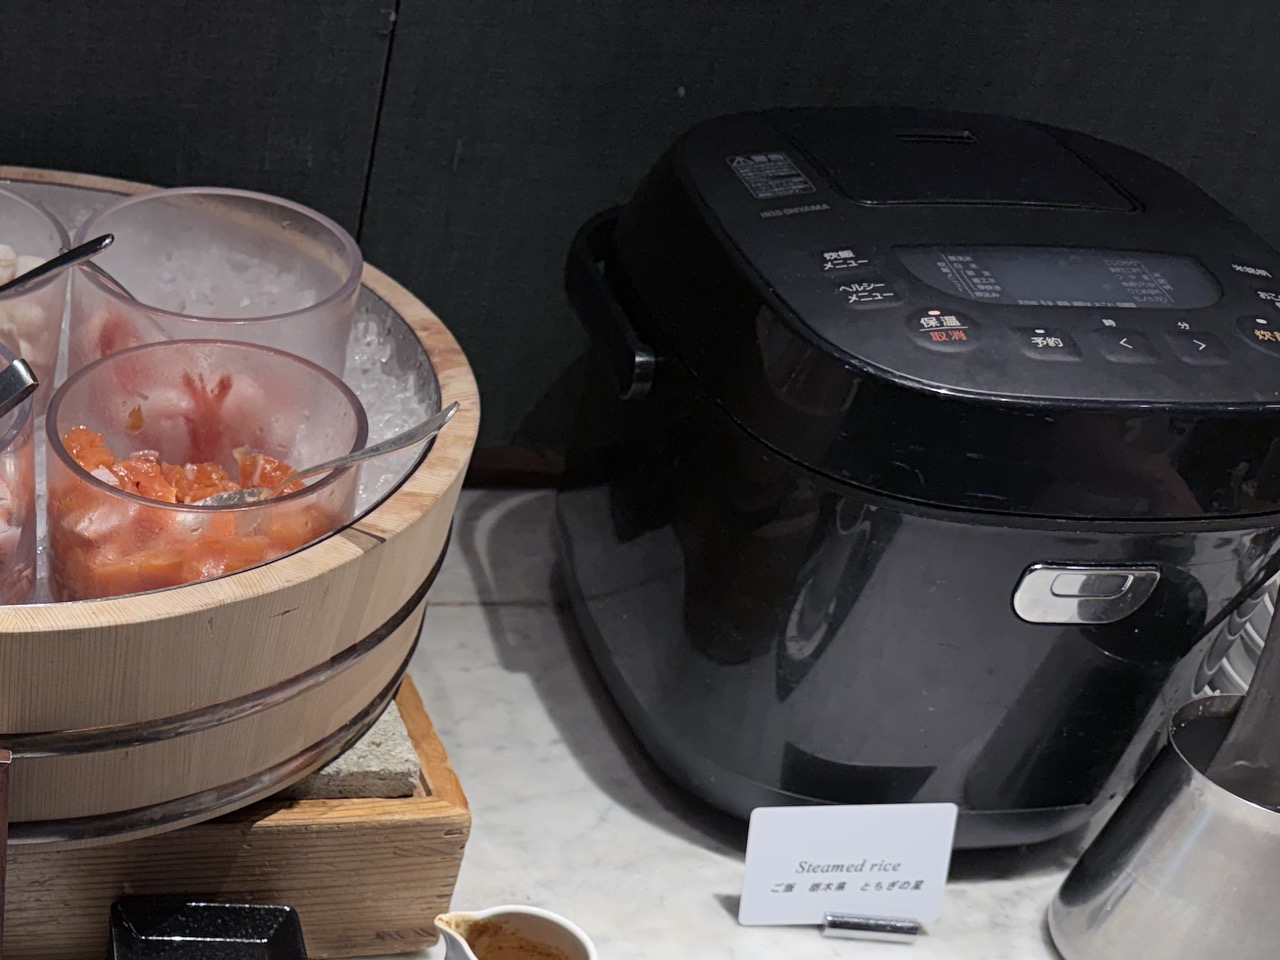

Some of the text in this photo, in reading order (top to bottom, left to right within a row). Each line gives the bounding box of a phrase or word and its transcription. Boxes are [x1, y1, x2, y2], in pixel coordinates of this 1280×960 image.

[823, 260, 869, 270] メニュー
[839, 282, 885, 292] ヘルシー
[848, 292, 894, 303] メニュー
[920, 316, 961, 328] 保温
[929, 329, 967, 342] 取消
[1031, 336, 1064, 348] 予約
[795, 859, 901, 874] Steamed rice
